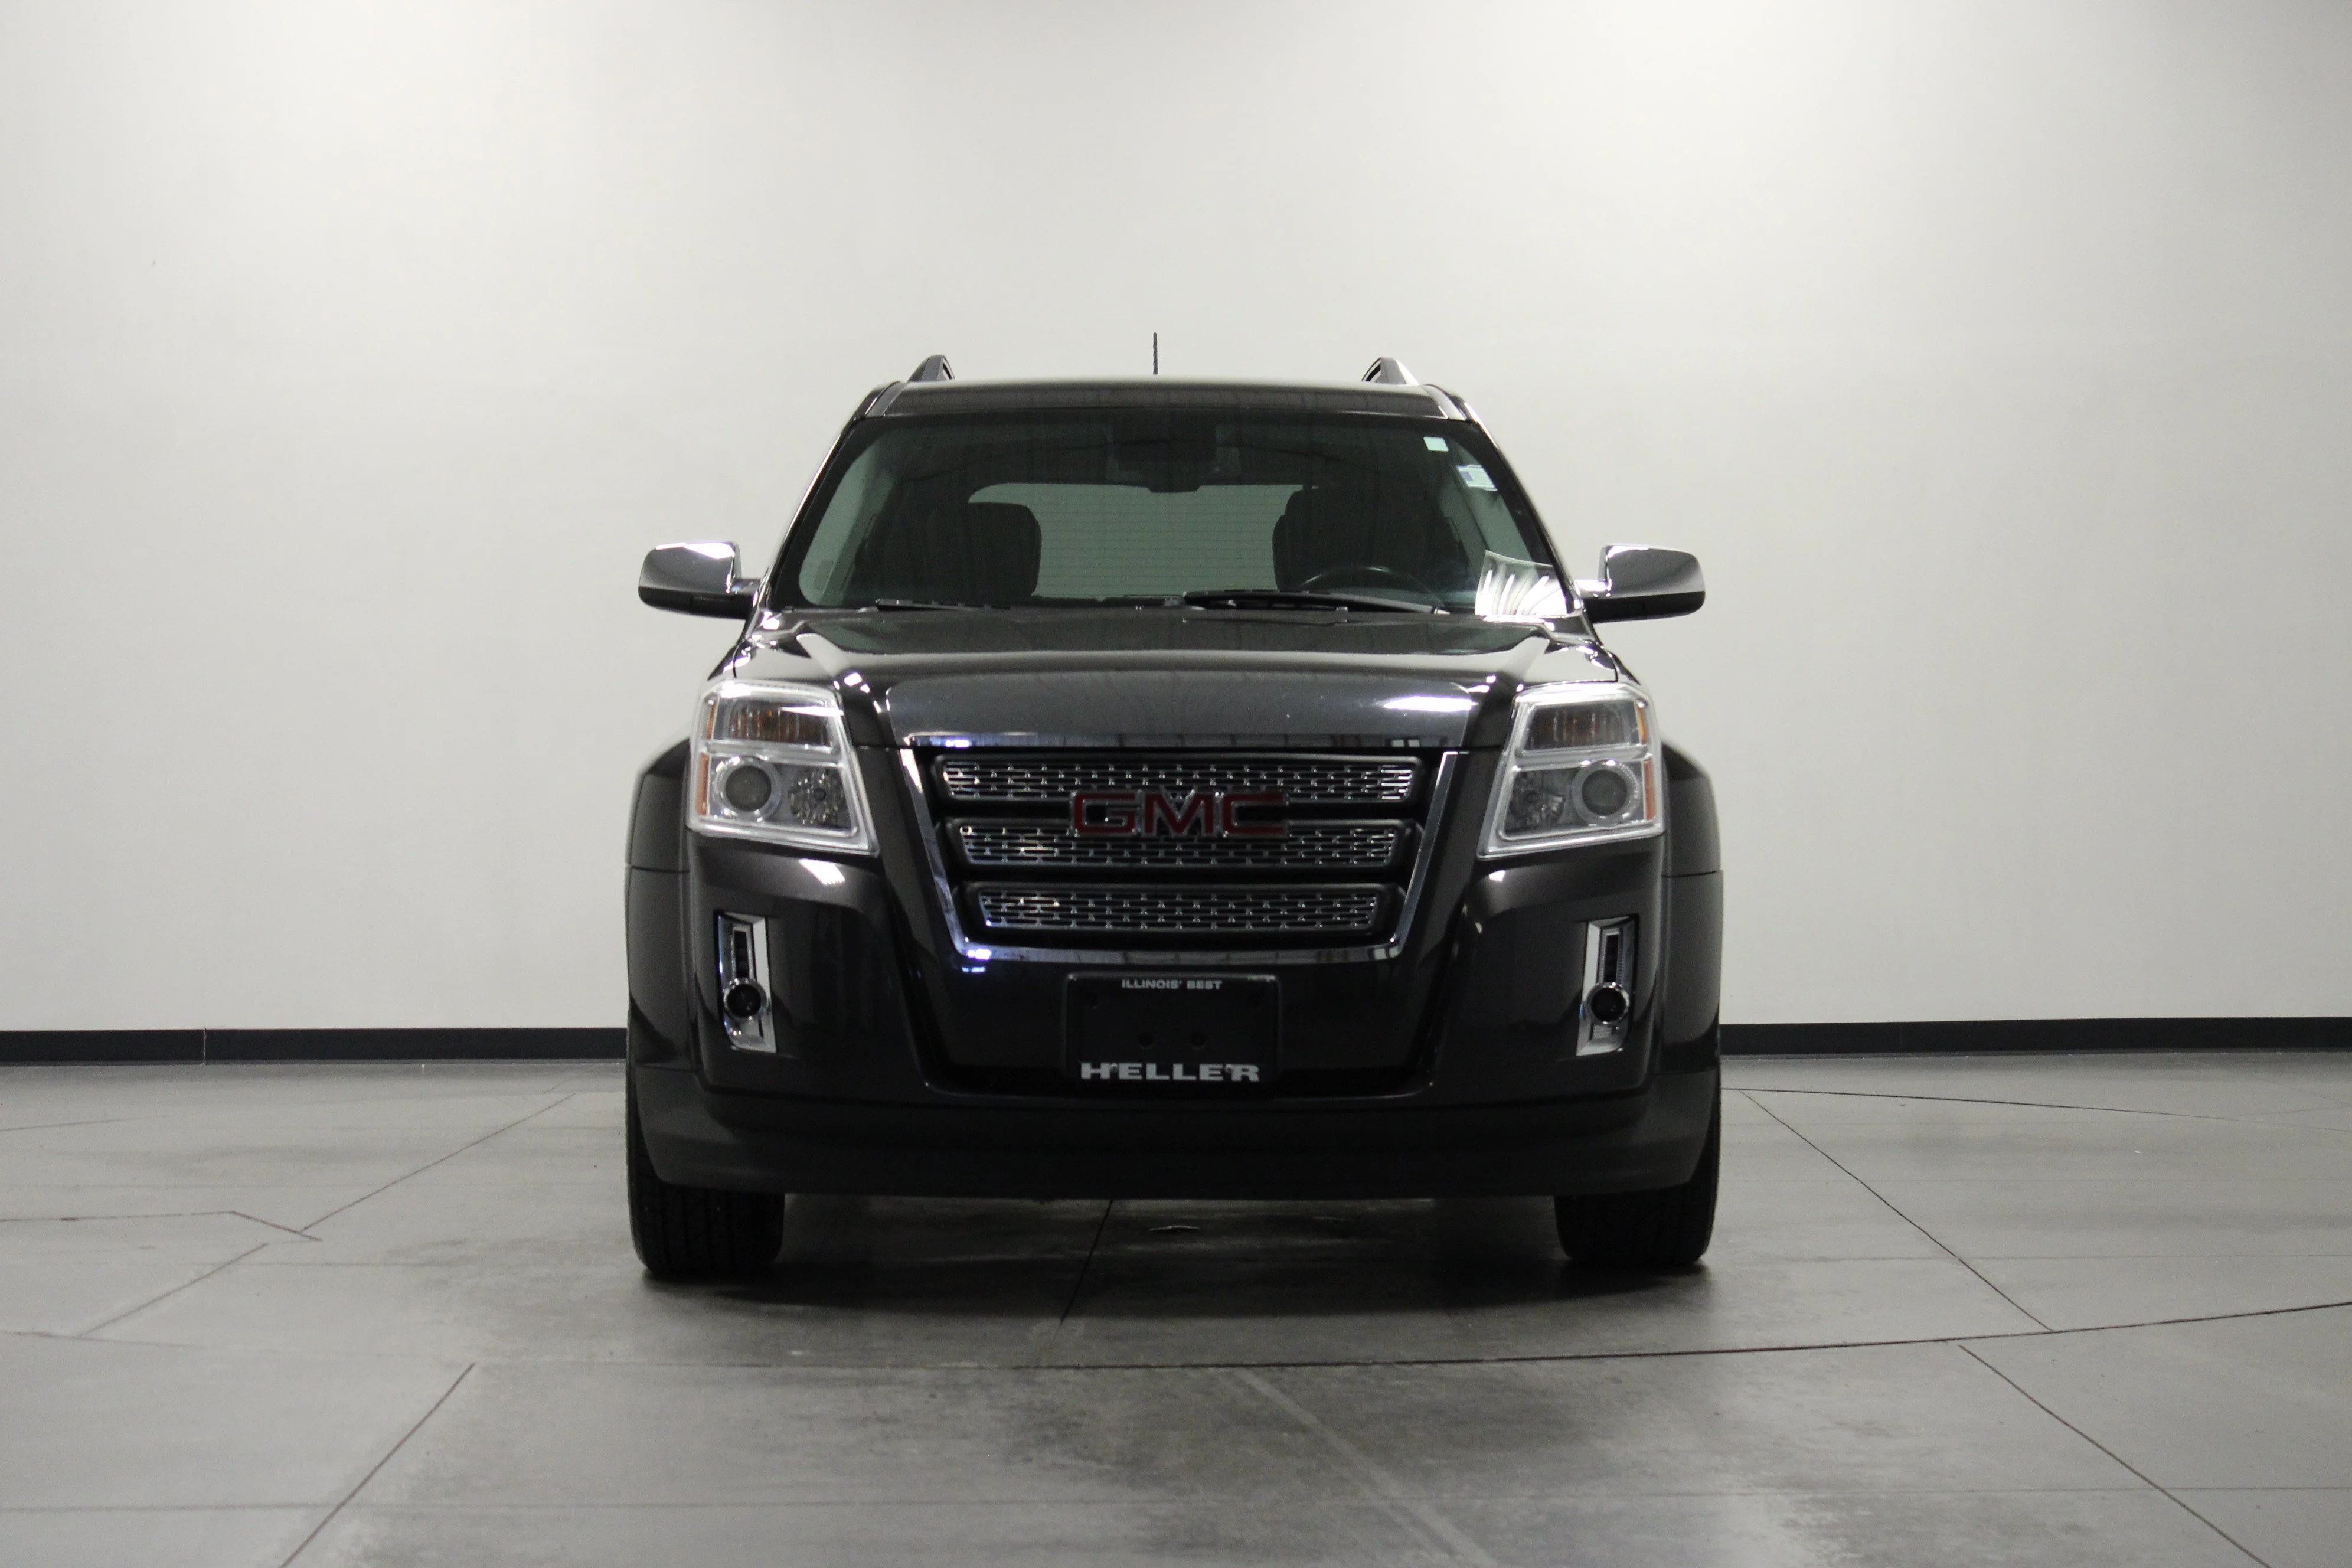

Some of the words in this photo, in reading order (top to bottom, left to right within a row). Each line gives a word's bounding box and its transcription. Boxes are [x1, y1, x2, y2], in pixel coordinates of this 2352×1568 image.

[1069, 789, 1289, 838] GMC
[1187, 980, 1223, 990] BEST
[1080, 1062, 1260, 1082] HELLER
